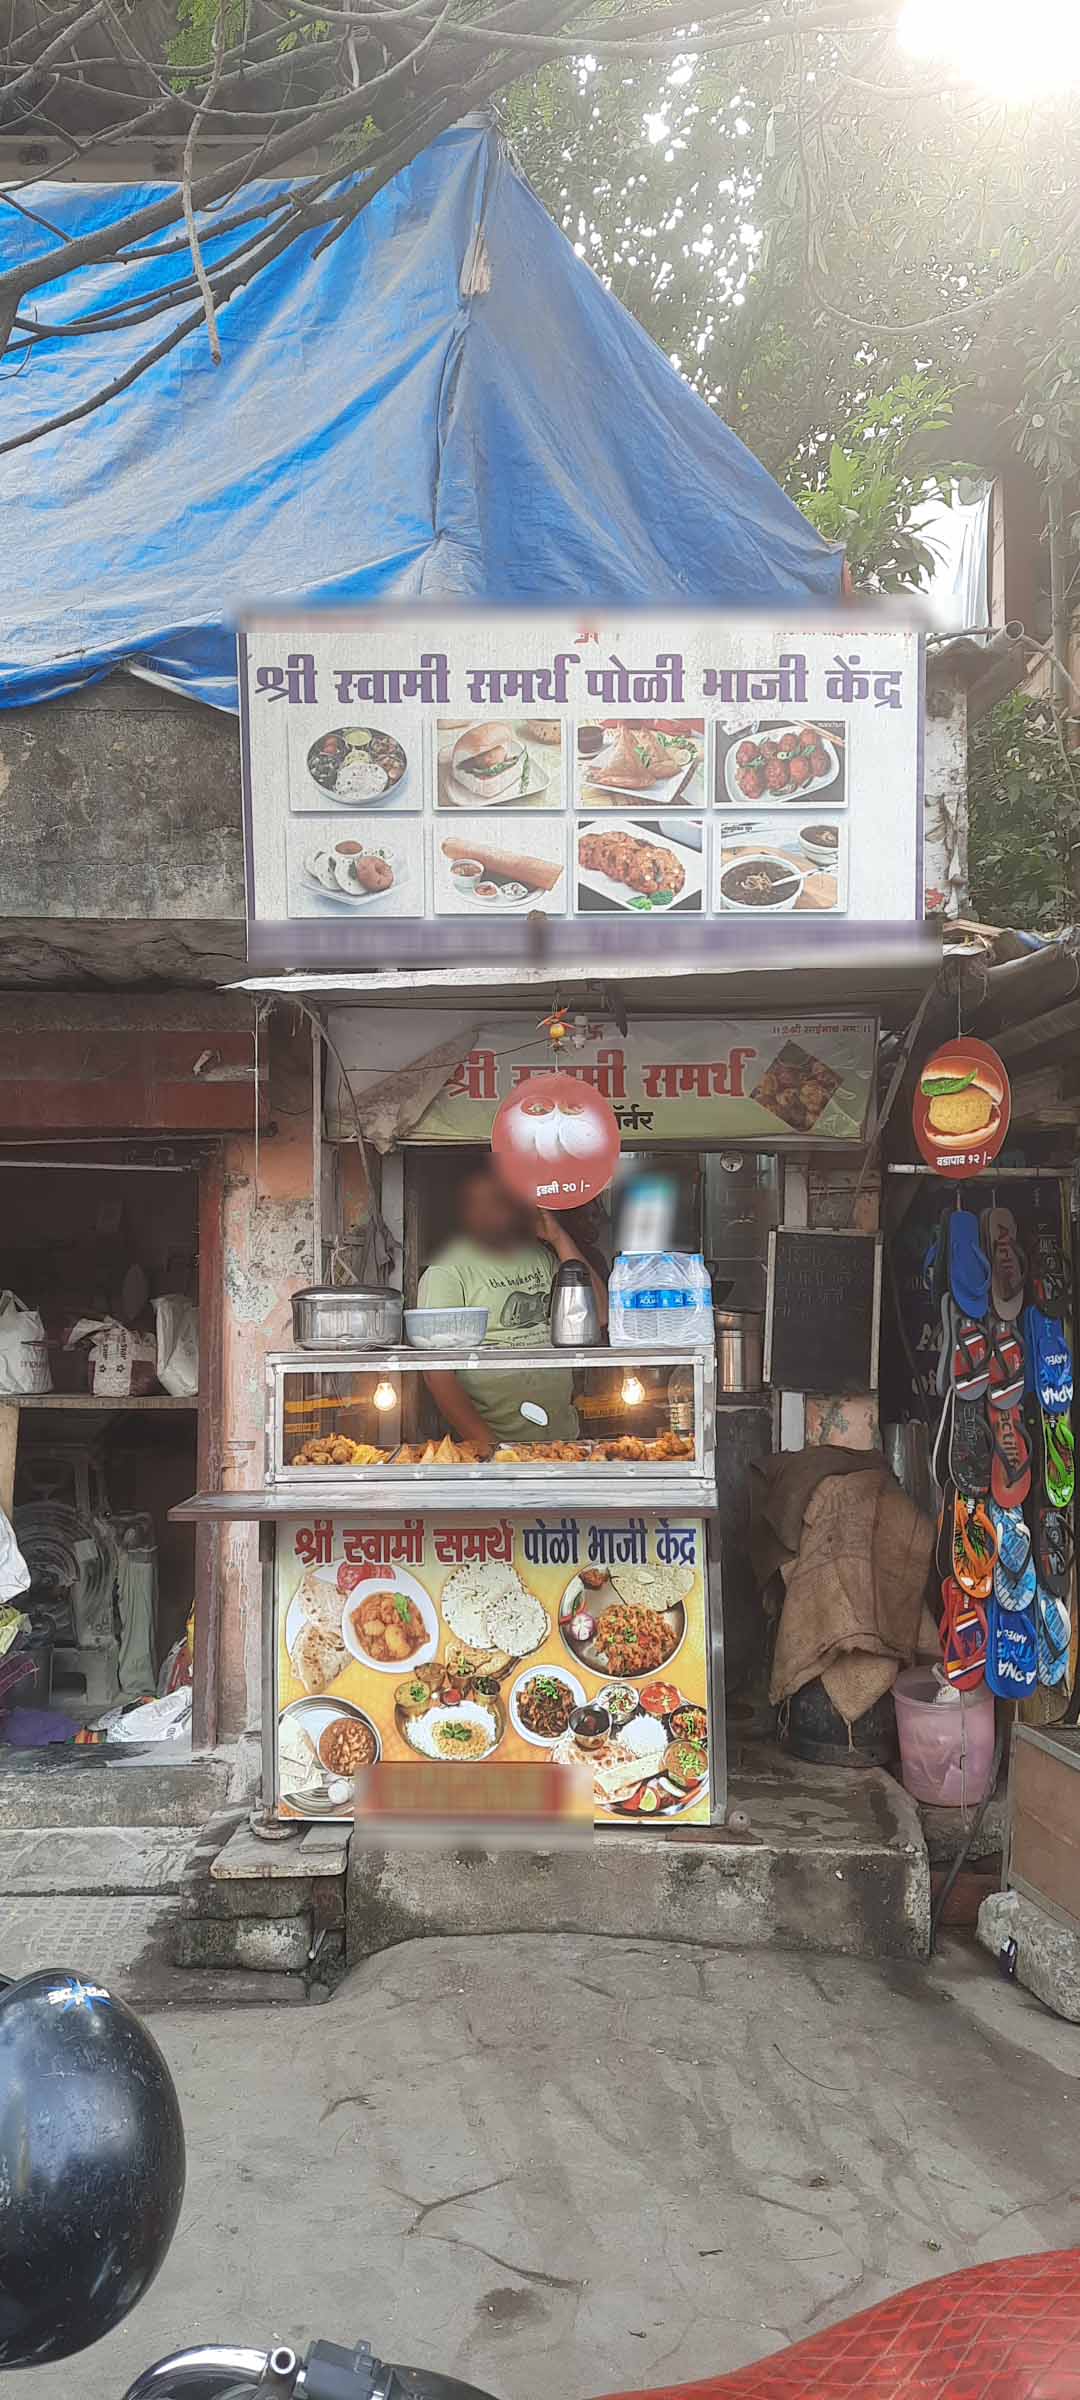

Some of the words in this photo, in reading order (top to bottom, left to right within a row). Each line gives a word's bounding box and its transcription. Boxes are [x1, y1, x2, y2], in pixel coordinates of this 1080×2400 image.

[255, 654, 318, 704] श्री
[333, 654, 451, 704] स्वामी
[466, 654, 580, 704] समर्थ
[585, 654, 685, 703] पोळी
[703, 654, 808, 703] भाजी
[824, 654, 902, 708] केंद्र
[642, 1047, 758, 1098] समर्थ
[936, 1155, 966, 1167] वडापाव
[968, 1154, 980, 1164] १२
[562, 1182, 577, 1192] २०
[294, 1519, 334, 1565] श्री
[343, 1519, 425, 1564] स्वामी
[433, 1519, 515, 1564] समर्थ
[523, 1518, 579, 1564] पोळी
[588, 1518, 648, 1564] भाजी
